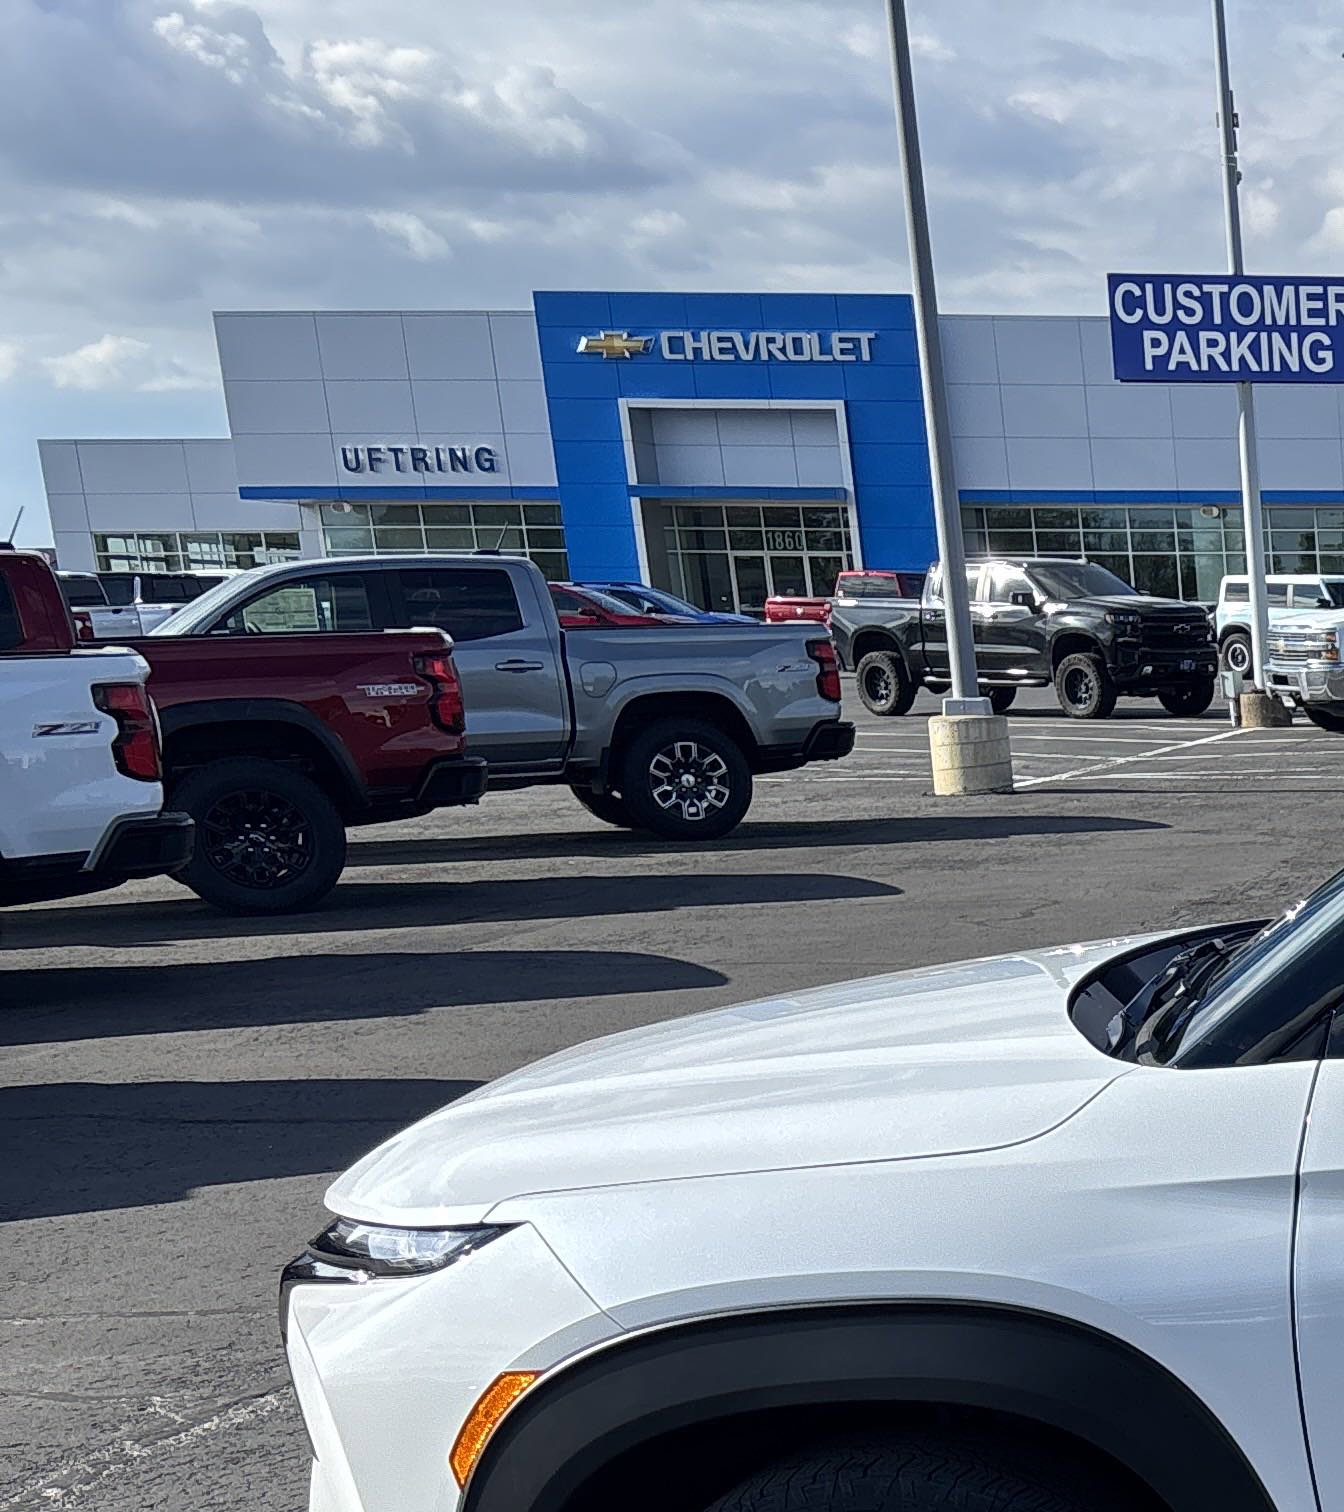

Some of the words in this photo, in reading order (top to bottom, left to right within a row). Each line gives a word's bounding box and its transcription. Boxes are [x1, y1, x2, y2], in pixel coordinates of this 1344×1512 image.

[660, 330, 877, 361] CHEVROLET
[1142, 330, 1334, 373] PARKING
[340, 446, 499, 473] UFTRING
[766, 531, 804, 551] 1860
